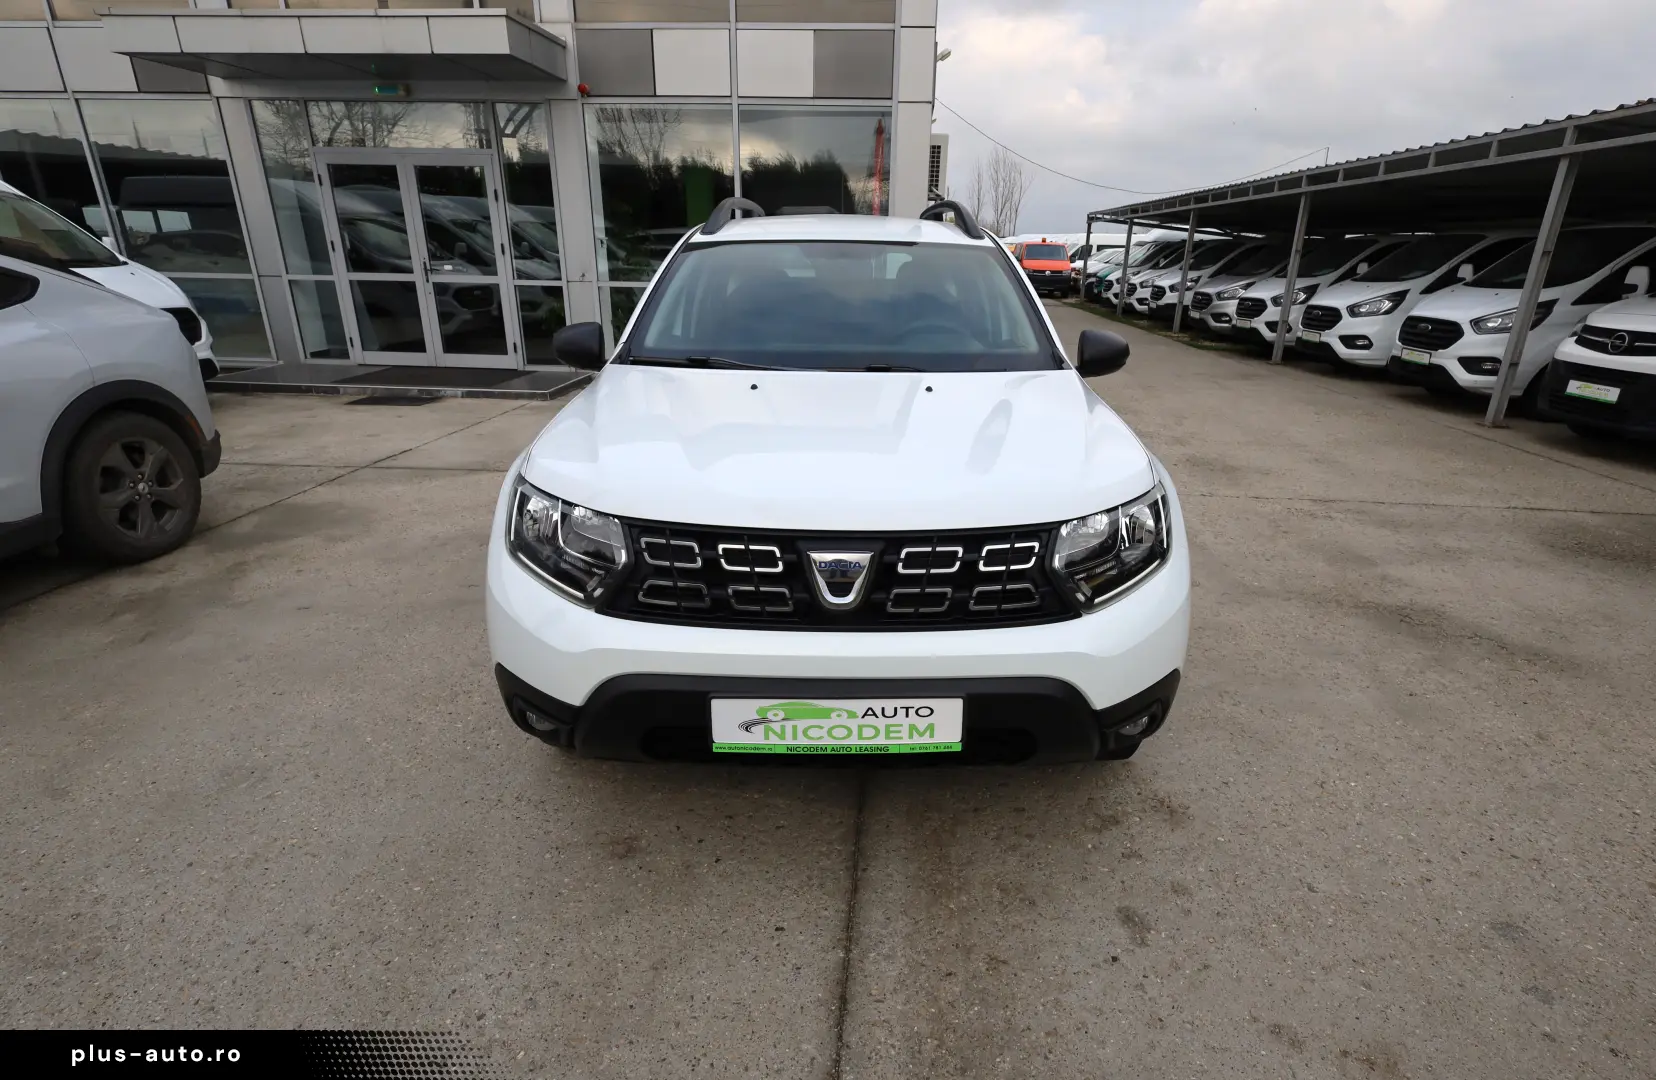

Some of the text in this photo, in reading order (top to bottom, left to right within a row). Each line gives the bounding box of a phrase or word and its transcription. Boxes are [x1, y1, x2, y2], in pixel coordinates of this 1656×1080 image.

[818, 561, 862, 569] DACIA
[861, 706, 935, 719] AUTO
[763, 723, 935, 741] NICODEM
